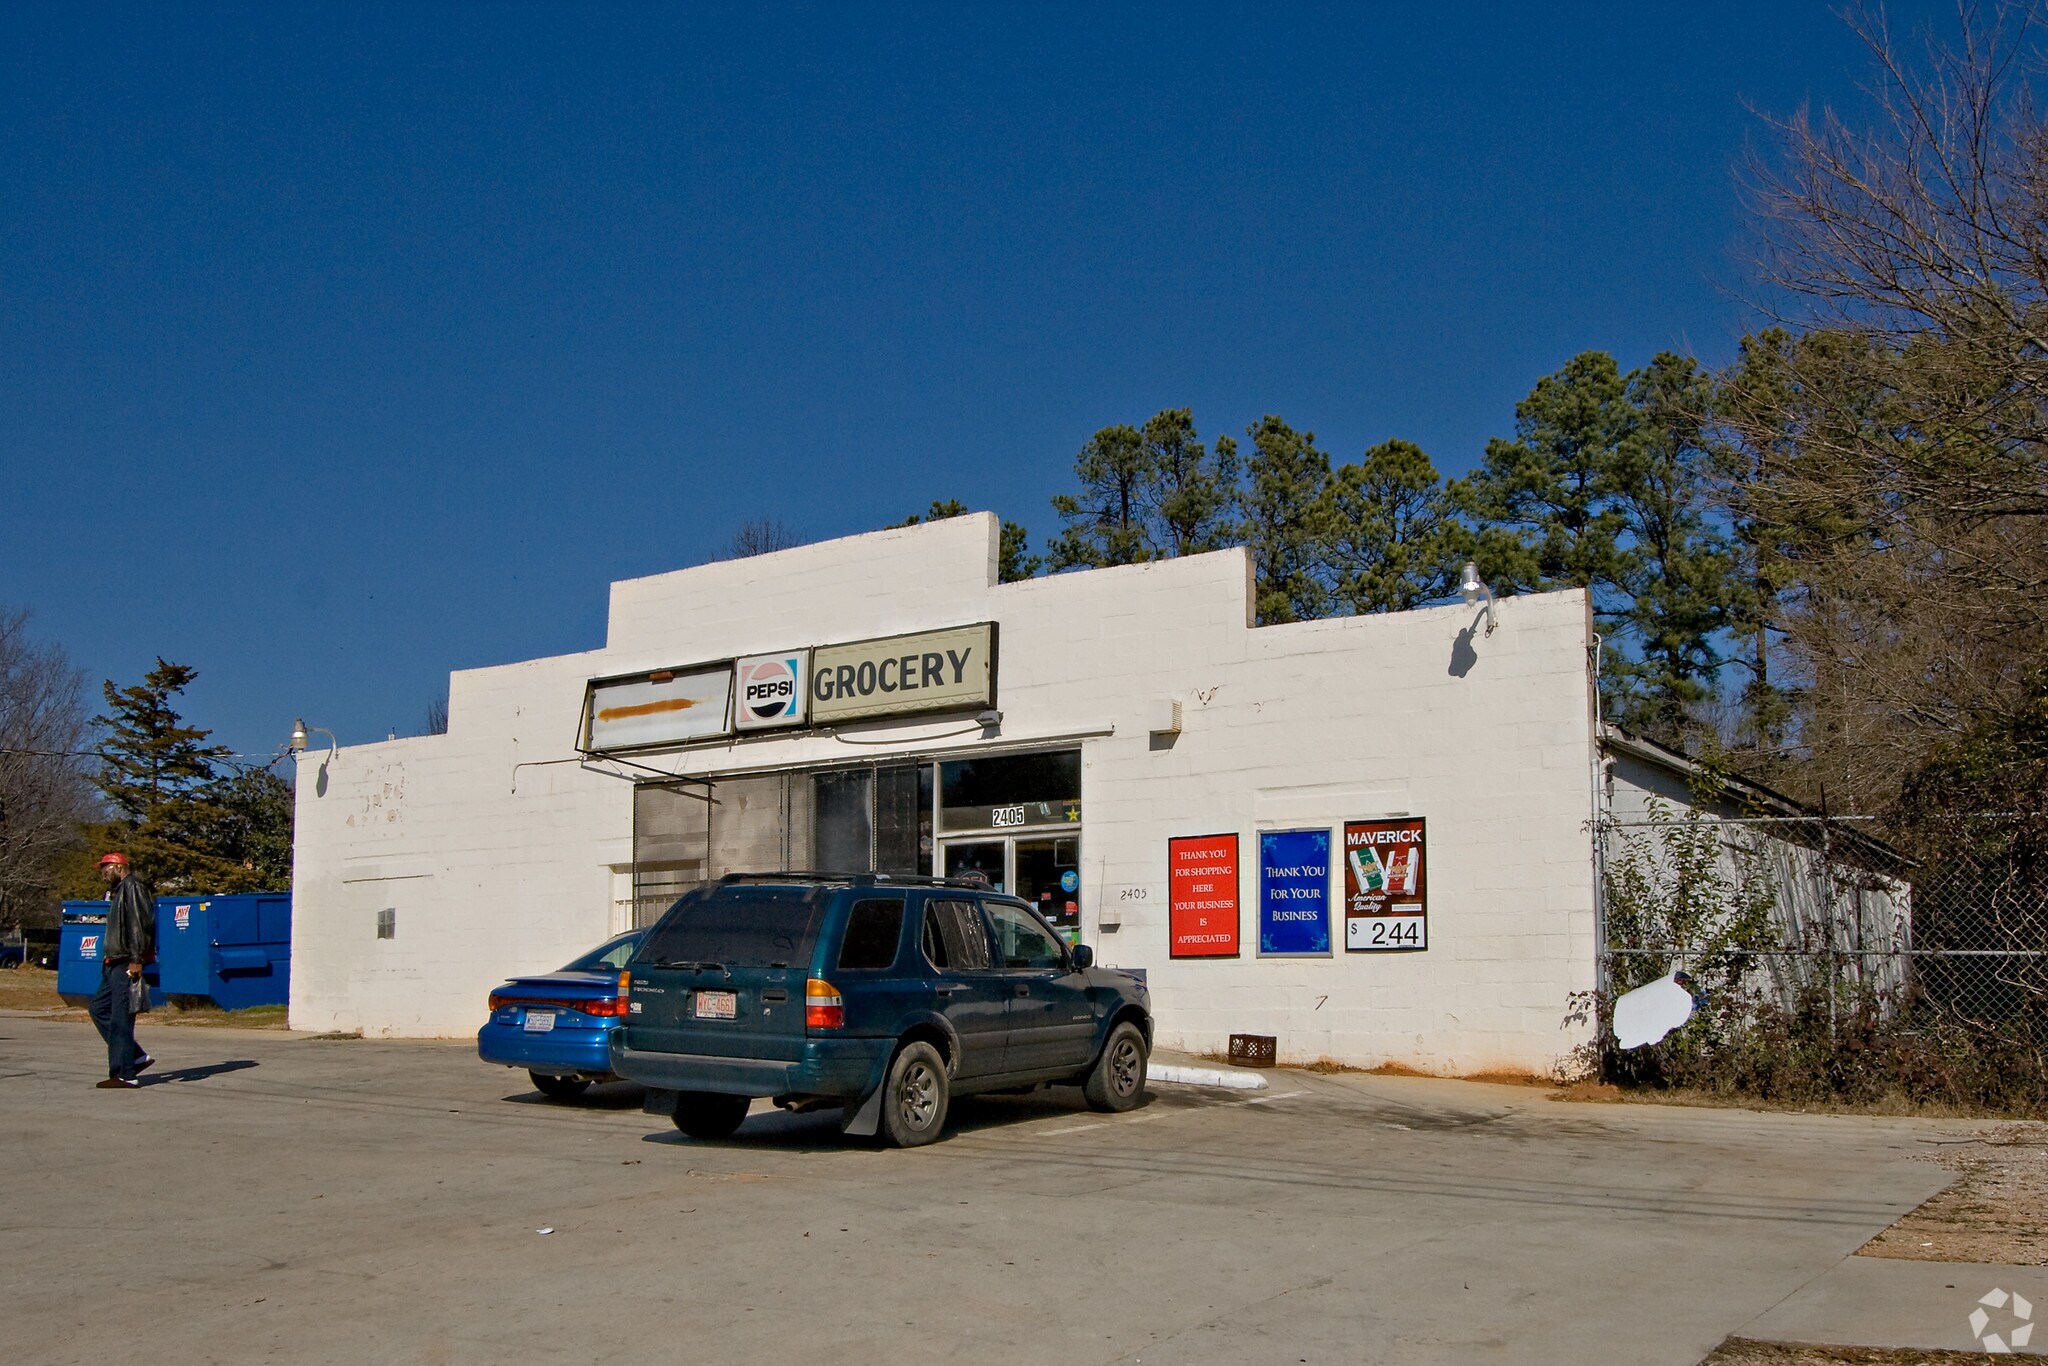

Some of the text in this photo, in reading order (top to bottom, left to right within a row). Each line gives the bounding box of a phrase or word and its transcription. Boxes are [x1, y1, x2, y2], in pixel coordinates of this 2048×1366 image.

[814, 647, 972, 702] GROCERY
[746, 680, 793, 700] PEPSI
[993, 807, 1024, 827] 2405
[1347, 829, 1422, 845] MAVERICK
[1179, 849, 1227, 860] THANK YOU
[1175, 866, 1232, 877] FOR SHOPPING
[1265, 865, 1325, 878] THANK YOU
[1120, 888, 1147, 900] 2405
[1192, 884, 1214, 893] HERE
[1270, 887, 1321, 900] FOR YOUR
[1348, 893, 1387, 903] American
[1174, 900, 1234, 911] YOUR BUSINESS
[1353, 901, 1382, 914] Quality
[1272, 910, 1318, 921] BUSINESS
[1199, 918, 1207, 926] IS
[1177, 934, 1231, 944] APPRECIATED
[1350, 922, 1419, 946] $ 2.44
